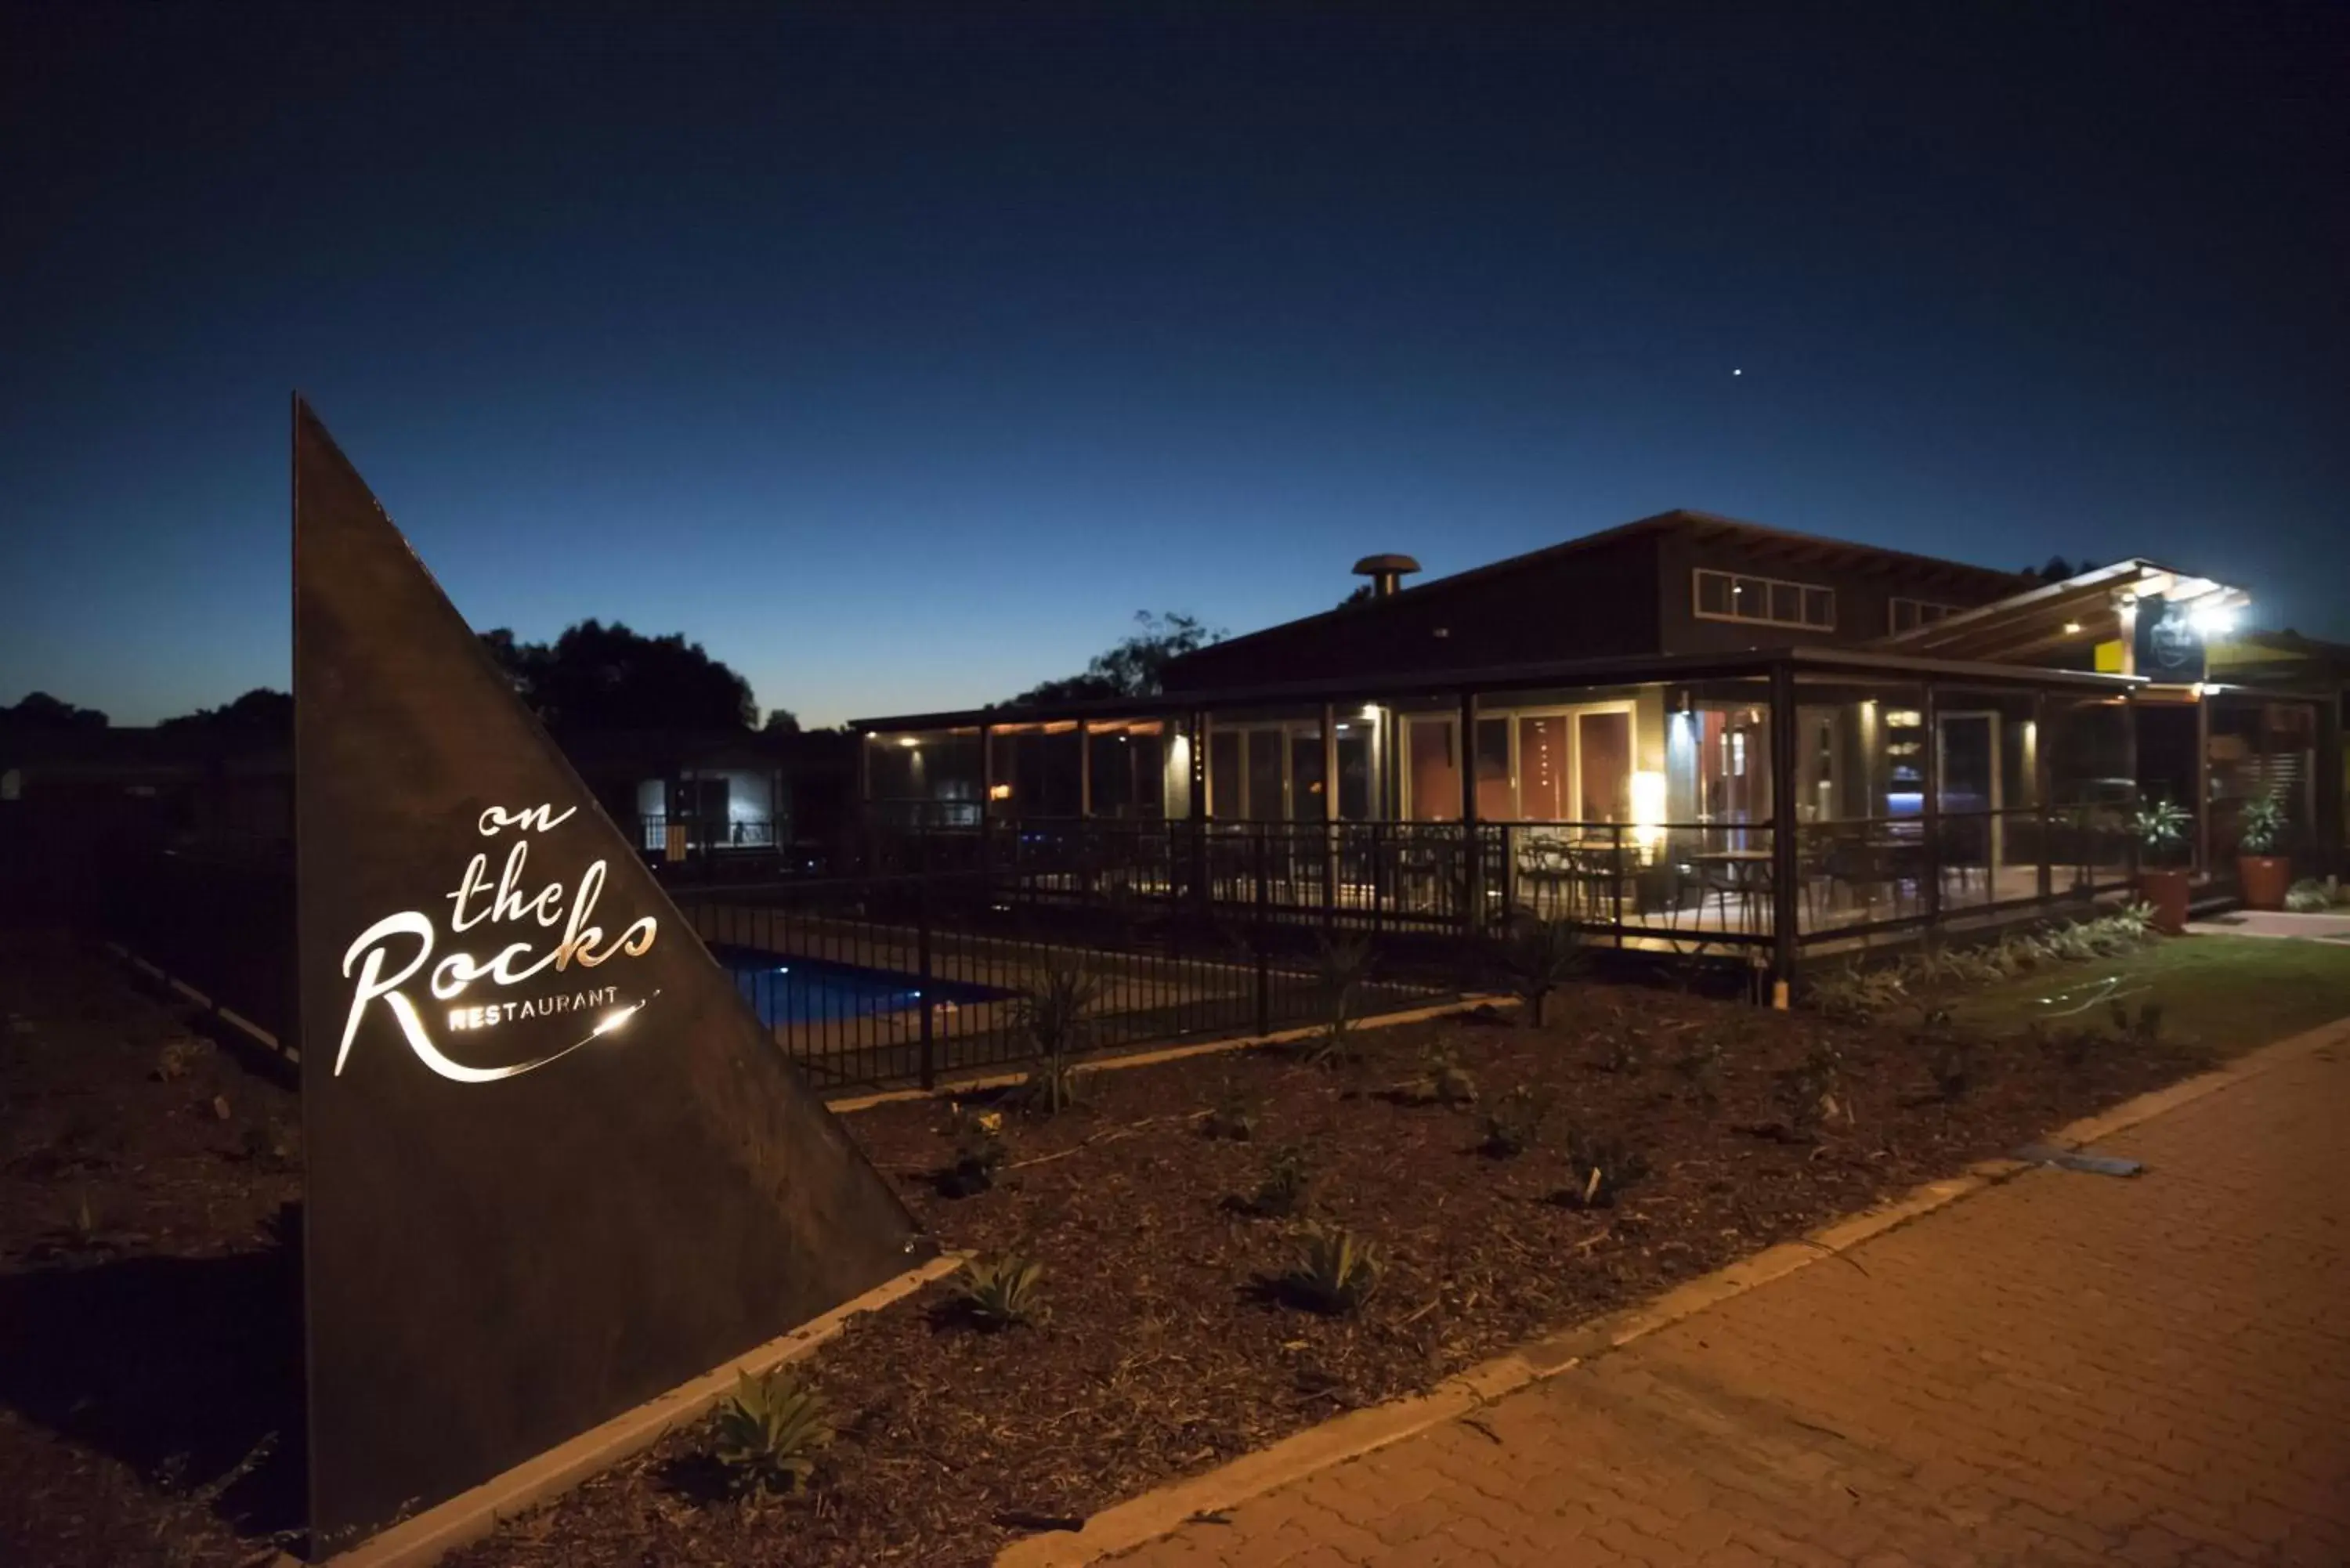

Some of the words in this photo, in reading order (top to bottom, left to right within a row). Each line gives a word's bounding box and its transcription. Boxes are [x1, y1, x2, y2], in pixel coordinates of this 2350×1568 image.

[479, 804, 577, 836] on
[446, 840, 564, 933] the
[334, 859, 658, 1083] Rocks
[450, 986, 617, 1032] RESTAURANT
